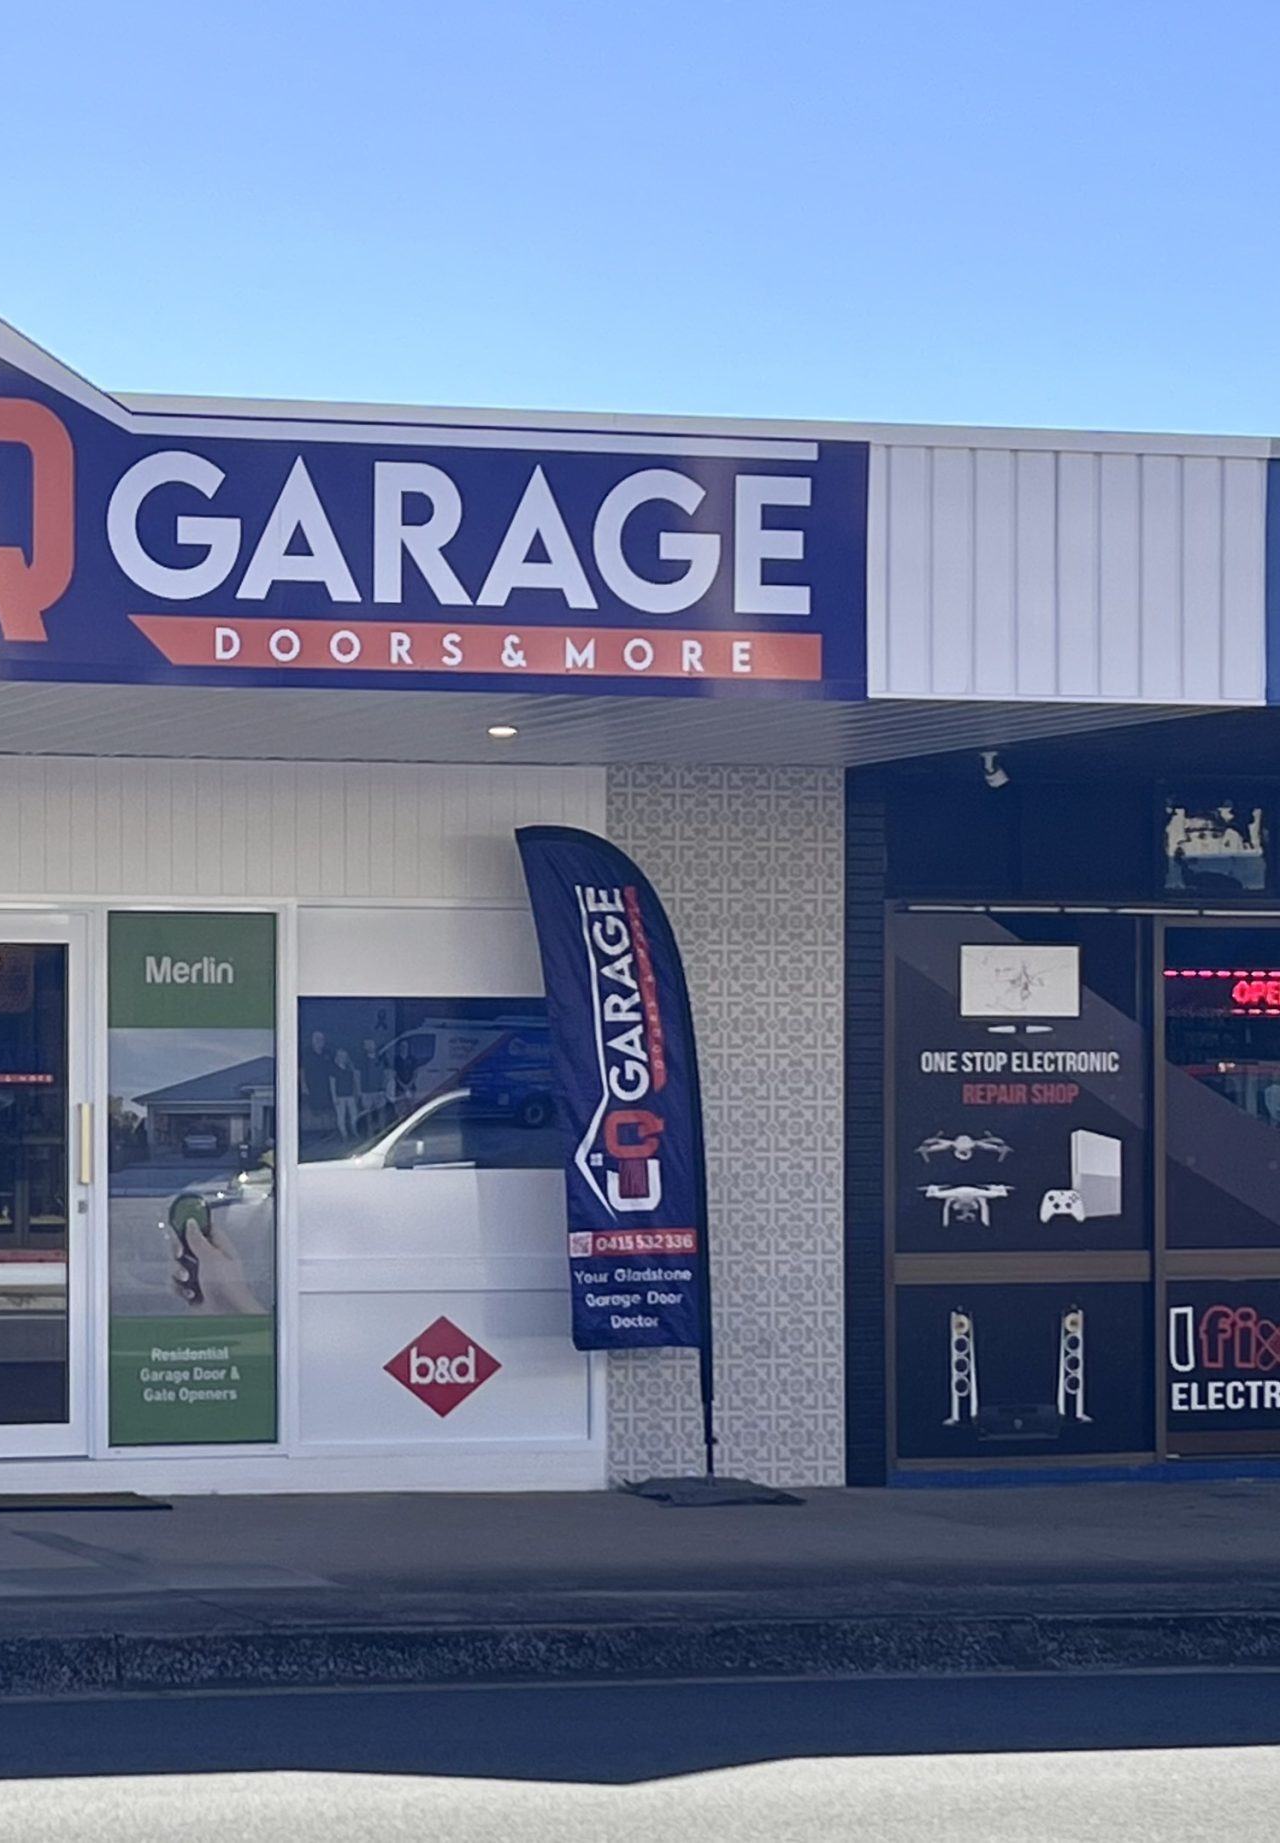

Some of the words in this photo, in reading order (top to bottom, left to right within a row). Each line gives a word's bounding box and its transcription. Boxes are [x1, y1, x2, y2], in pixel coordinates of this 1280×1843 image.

[106, 450, 811, 615] GARAGE
[215, 626, 463, 667] DOORS
[500, 634, 527, 667] &
[565, 637, 752, 672] MORE
[145, 955, 234, 984] Merlin
[585, 886, 650, 1102] GARAGE
[920, 1051, 958, 1073] ONE
[961, 1051, 1008, 1073] STOP
[1011, 1051, 1120, 1073] ELECTRONIC
[962, 1083, 1027, 1105] REPAIR
[1030, 1083, 1080, 1104] SHOP
[595, 1235, 635, 1251] 0415
[573, 1270, 609, 1285] Your
[613, 1267, 693, 1283] Gladstone
[585, 1292, 642, 1308] Garage
[646, 1290, 683, 1305] Door
[610, 1314, 659, 1329] Doctor
[151, 1346, 229, 1361] Residential
[140, 1367, 191, 1385] Garage
[193, 1366, 227, 1381] Door
[230, 1365, 240, 1380] &
[409, 1345, 476, 1385] b&d
[143, 1387, 177, 1402] Gate
[178, 1386, 238, 1404] Openers
